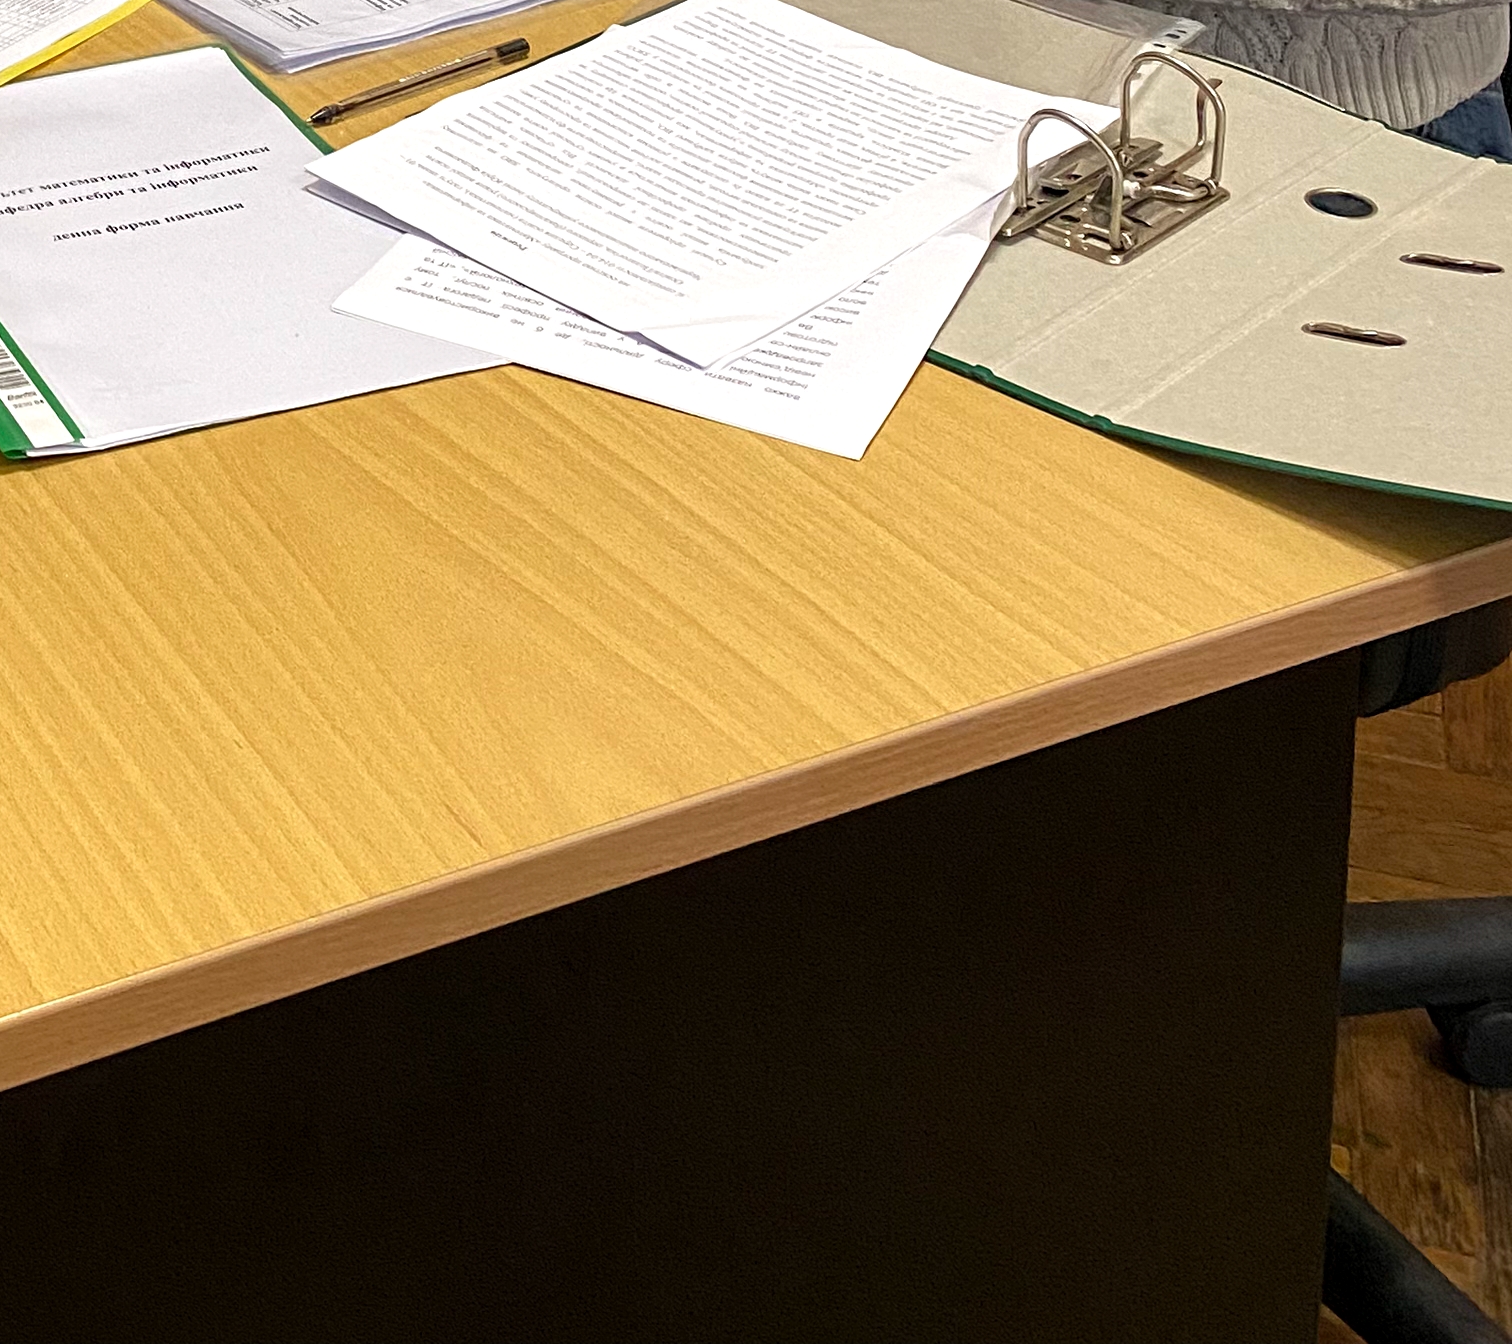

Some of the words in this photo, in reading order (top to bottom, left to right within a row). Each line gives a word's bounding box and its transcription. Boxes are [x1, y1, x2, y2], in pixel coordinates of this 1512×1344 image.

[39, 170, 138, 191] математики
[142, 167, 161, 175] та
[163, 145, 270, 171] інформатики
[58, 189, 124, 206] алгебри
[128, 186, 147, 195] та
[150, 164, 258, 190] інформатики
[53, 226, 102, 242] денна
[105, 218, 161, 234] форма
[165, 202, 245, 224] навчання
